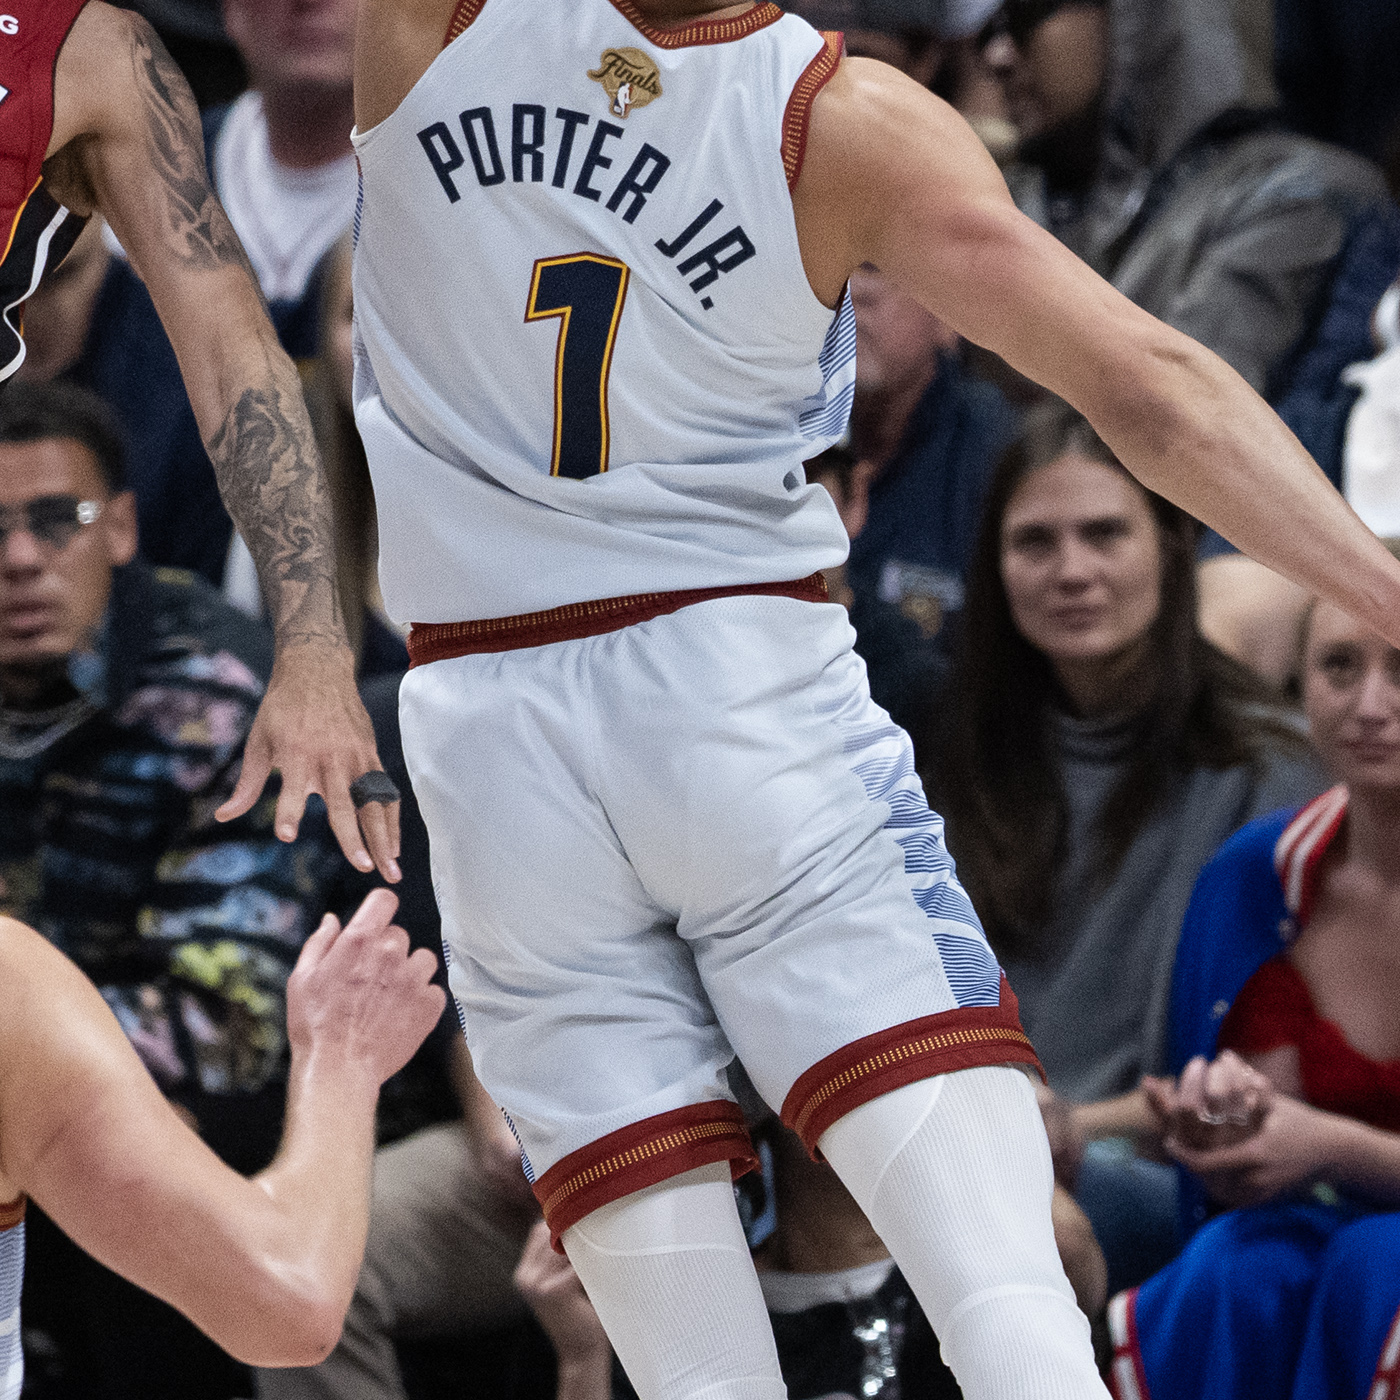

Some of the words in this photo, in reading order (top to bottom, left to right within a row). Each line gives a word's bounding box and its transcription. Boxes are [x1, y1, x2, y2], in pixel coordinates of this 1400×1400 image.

[589, 52, 660, 96] Finals
[416, 103, 671, 225] PORTER
[653, 198, 757, 312] JR.
[524, 251, 631, 482] 1
